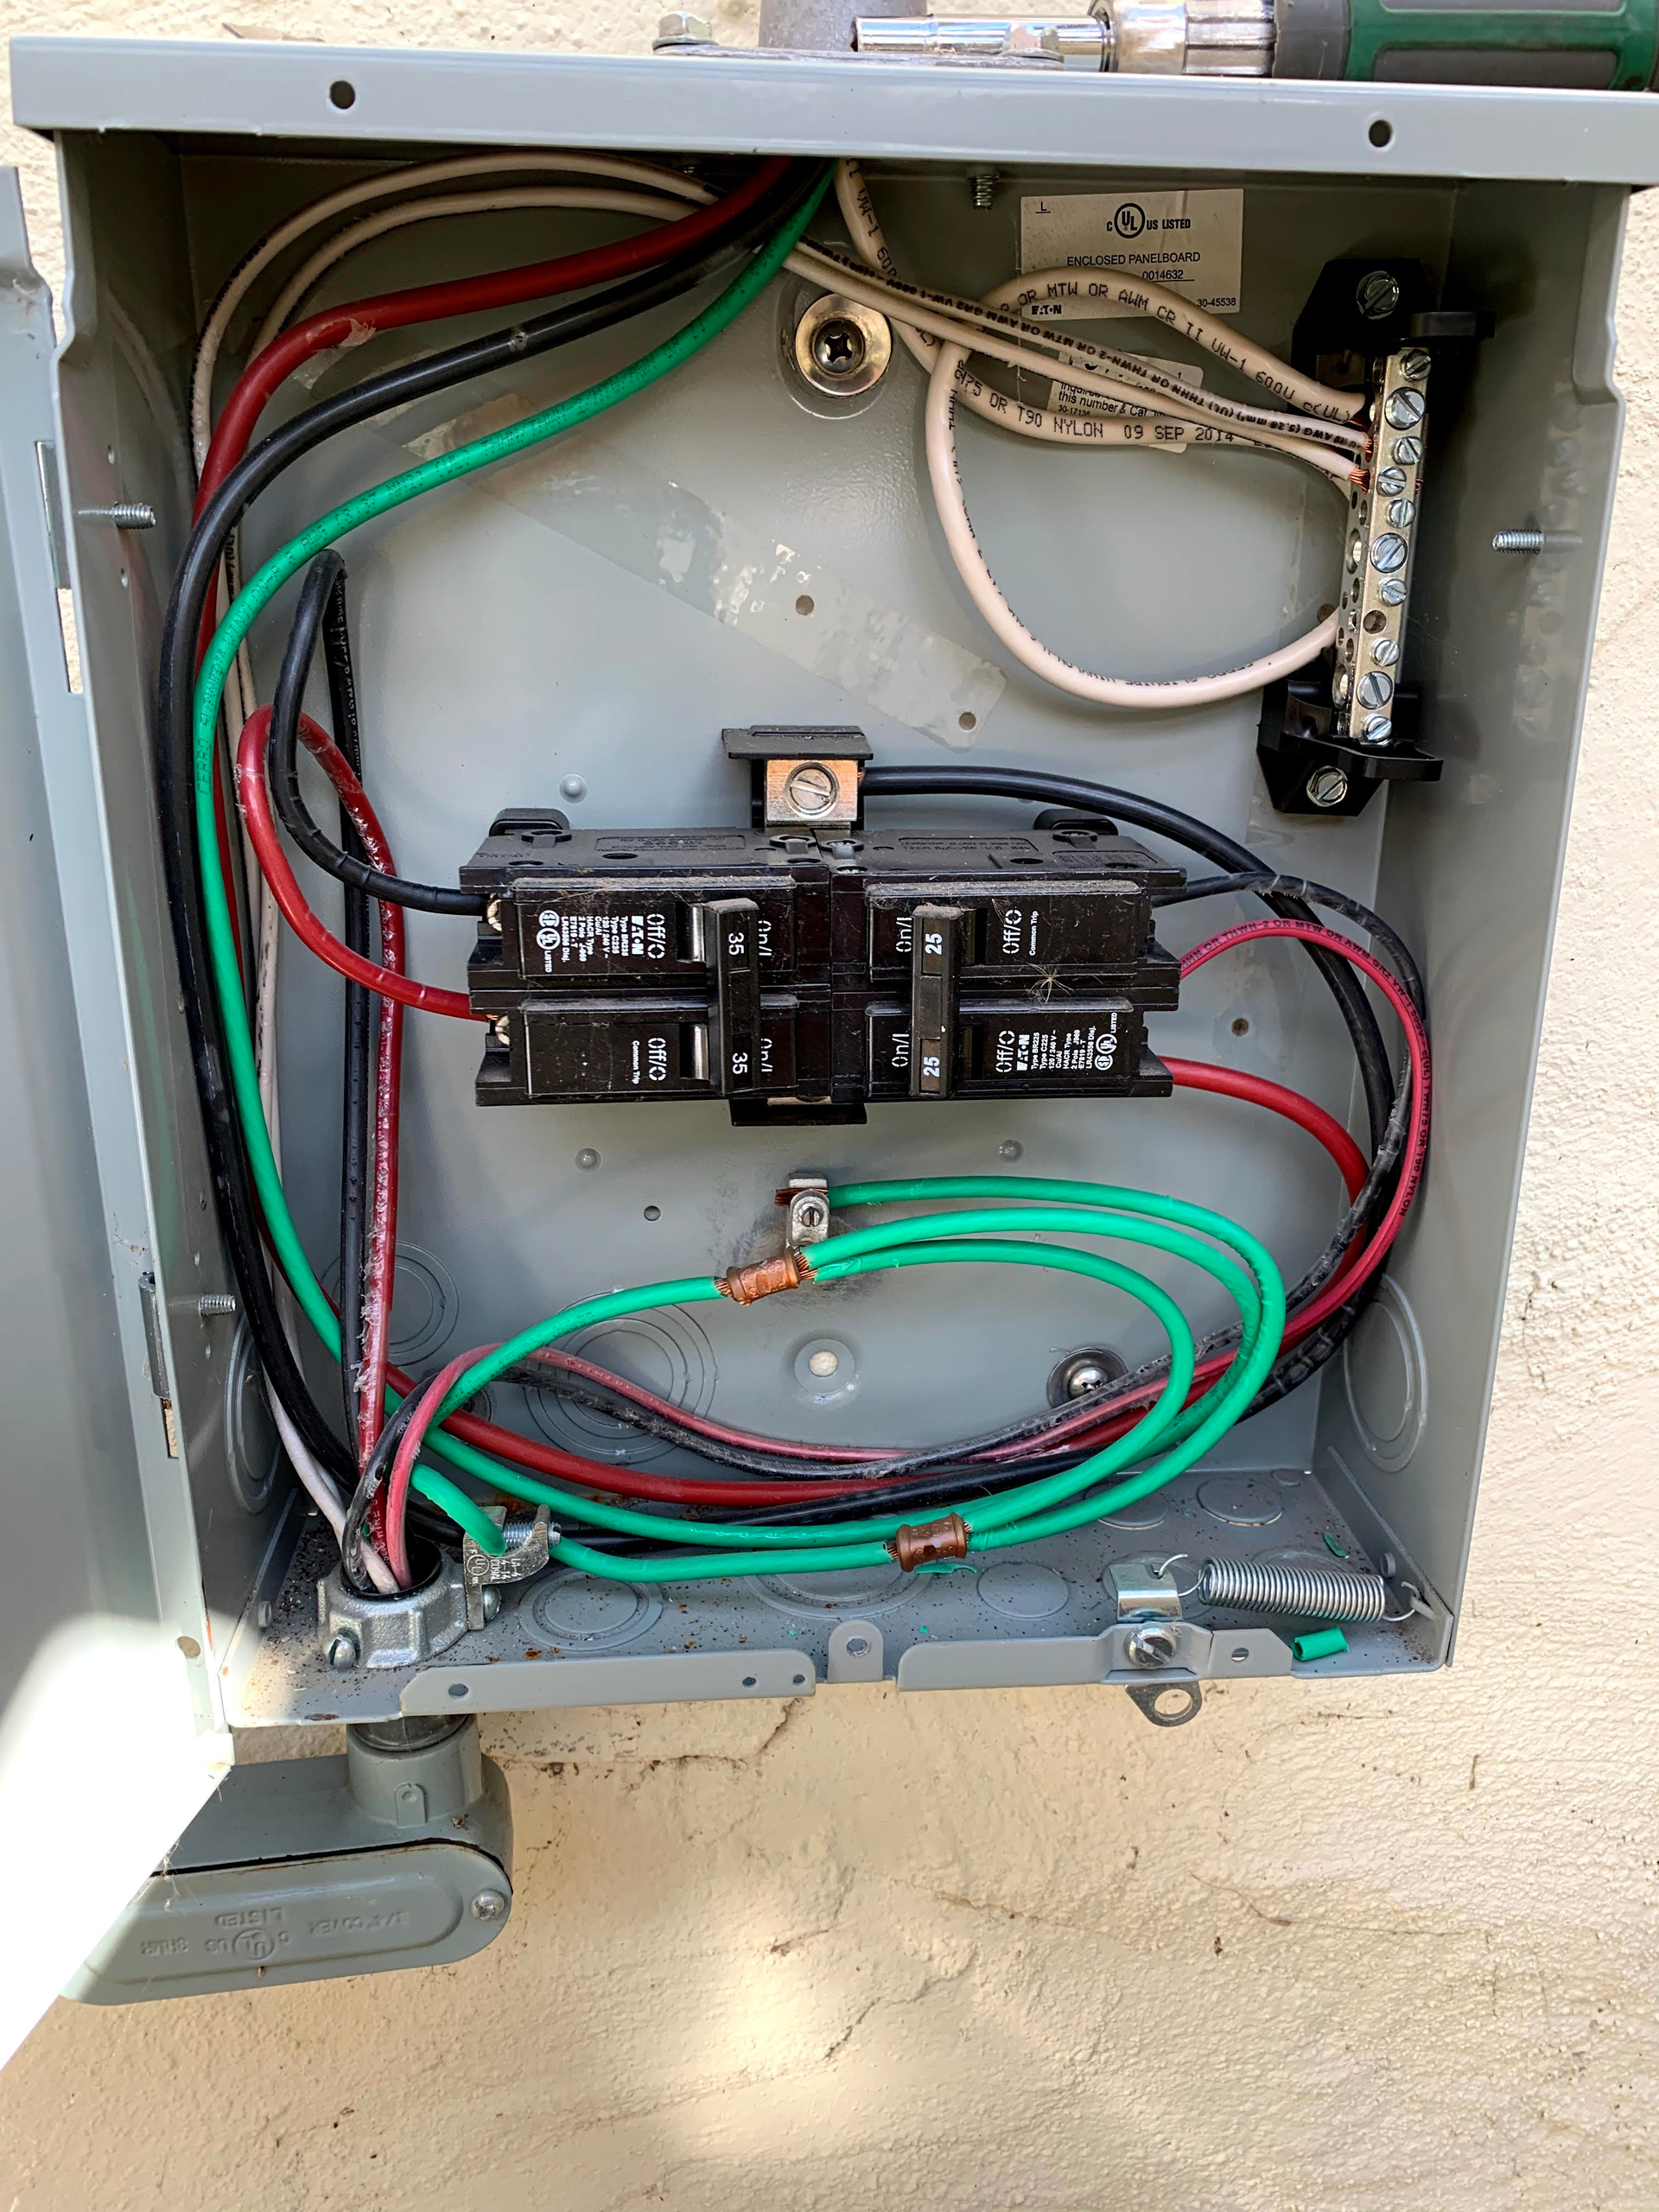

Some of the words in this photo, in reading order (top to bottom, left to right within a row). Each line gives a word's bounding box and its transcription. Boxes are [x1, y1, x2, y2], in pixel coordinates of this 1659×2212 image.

[1146, 219, 1159, 230] US
[1161, 218, 1192, 230] LISTED
[1066, 254, 1126, 267] ENCLOSED
[1128, 251, 1201, 264] PANELBOARD
[1141, 270, 1184, 281] 0014632
[1046, 282, 1078, 298] MTW
[1088, 283, 1109, 297] OR
[1118, 289, 1149, 311] AWM
[1197, 297, 1236, 308] 30-45538
[1031, 304, 1062, 315] EATON
[1020, 321, 1041, 336] OR
[1043, 329, 1075, 348] MTW
[1078, 342, 1097, 356] OR
[1151, 372, 1170, 390] OR
[1058, 390, 1077, 404] this
[1079, 396, 1119, 413] number
[1172, 384, 1205, 406] THHN
[989, 392, 1008, 414] OR
[1017, 405, 1043, 428] T90
[1053, 416, 1103, 438] NYLON
[1124, 424, 1143, 439] 09
[1154, 425, 1185, 441] SEP
[586, 916, 594, 938] HACR
[611, 916, 620, 933] Type
[620, 916, 628, 932] Type
[1030, 911, 1039, 926] Trip
[632, 915, 644, 955] EATON
[728, 932, 744, 956] 35
[925, 933, 943, 955] 25
[1029, 925, 1038, 957] Common
[585, 938, 594, 956] Type
[1109, 1012, 1118, 1033] LISTED
[1032, 1032, 1040, 1053] BR225
[1040, 1034, 1049, 1052] C225
[1064, 1033, 1072, 1048] Type
[1016, 1034, 1030, 1071] EATON
[1039, 1053, 1047, 1070] Type
[732, 1052, 748, 1074] 35
[923, 1057, 940, 1077] 25
[1296, 920, 1323, 932] MTW
[1399, 1175, 1419, 1217] NYLON
[632, 1071, 641, 1084] Trip
[215, 1906, 286, 1929] LISTED
